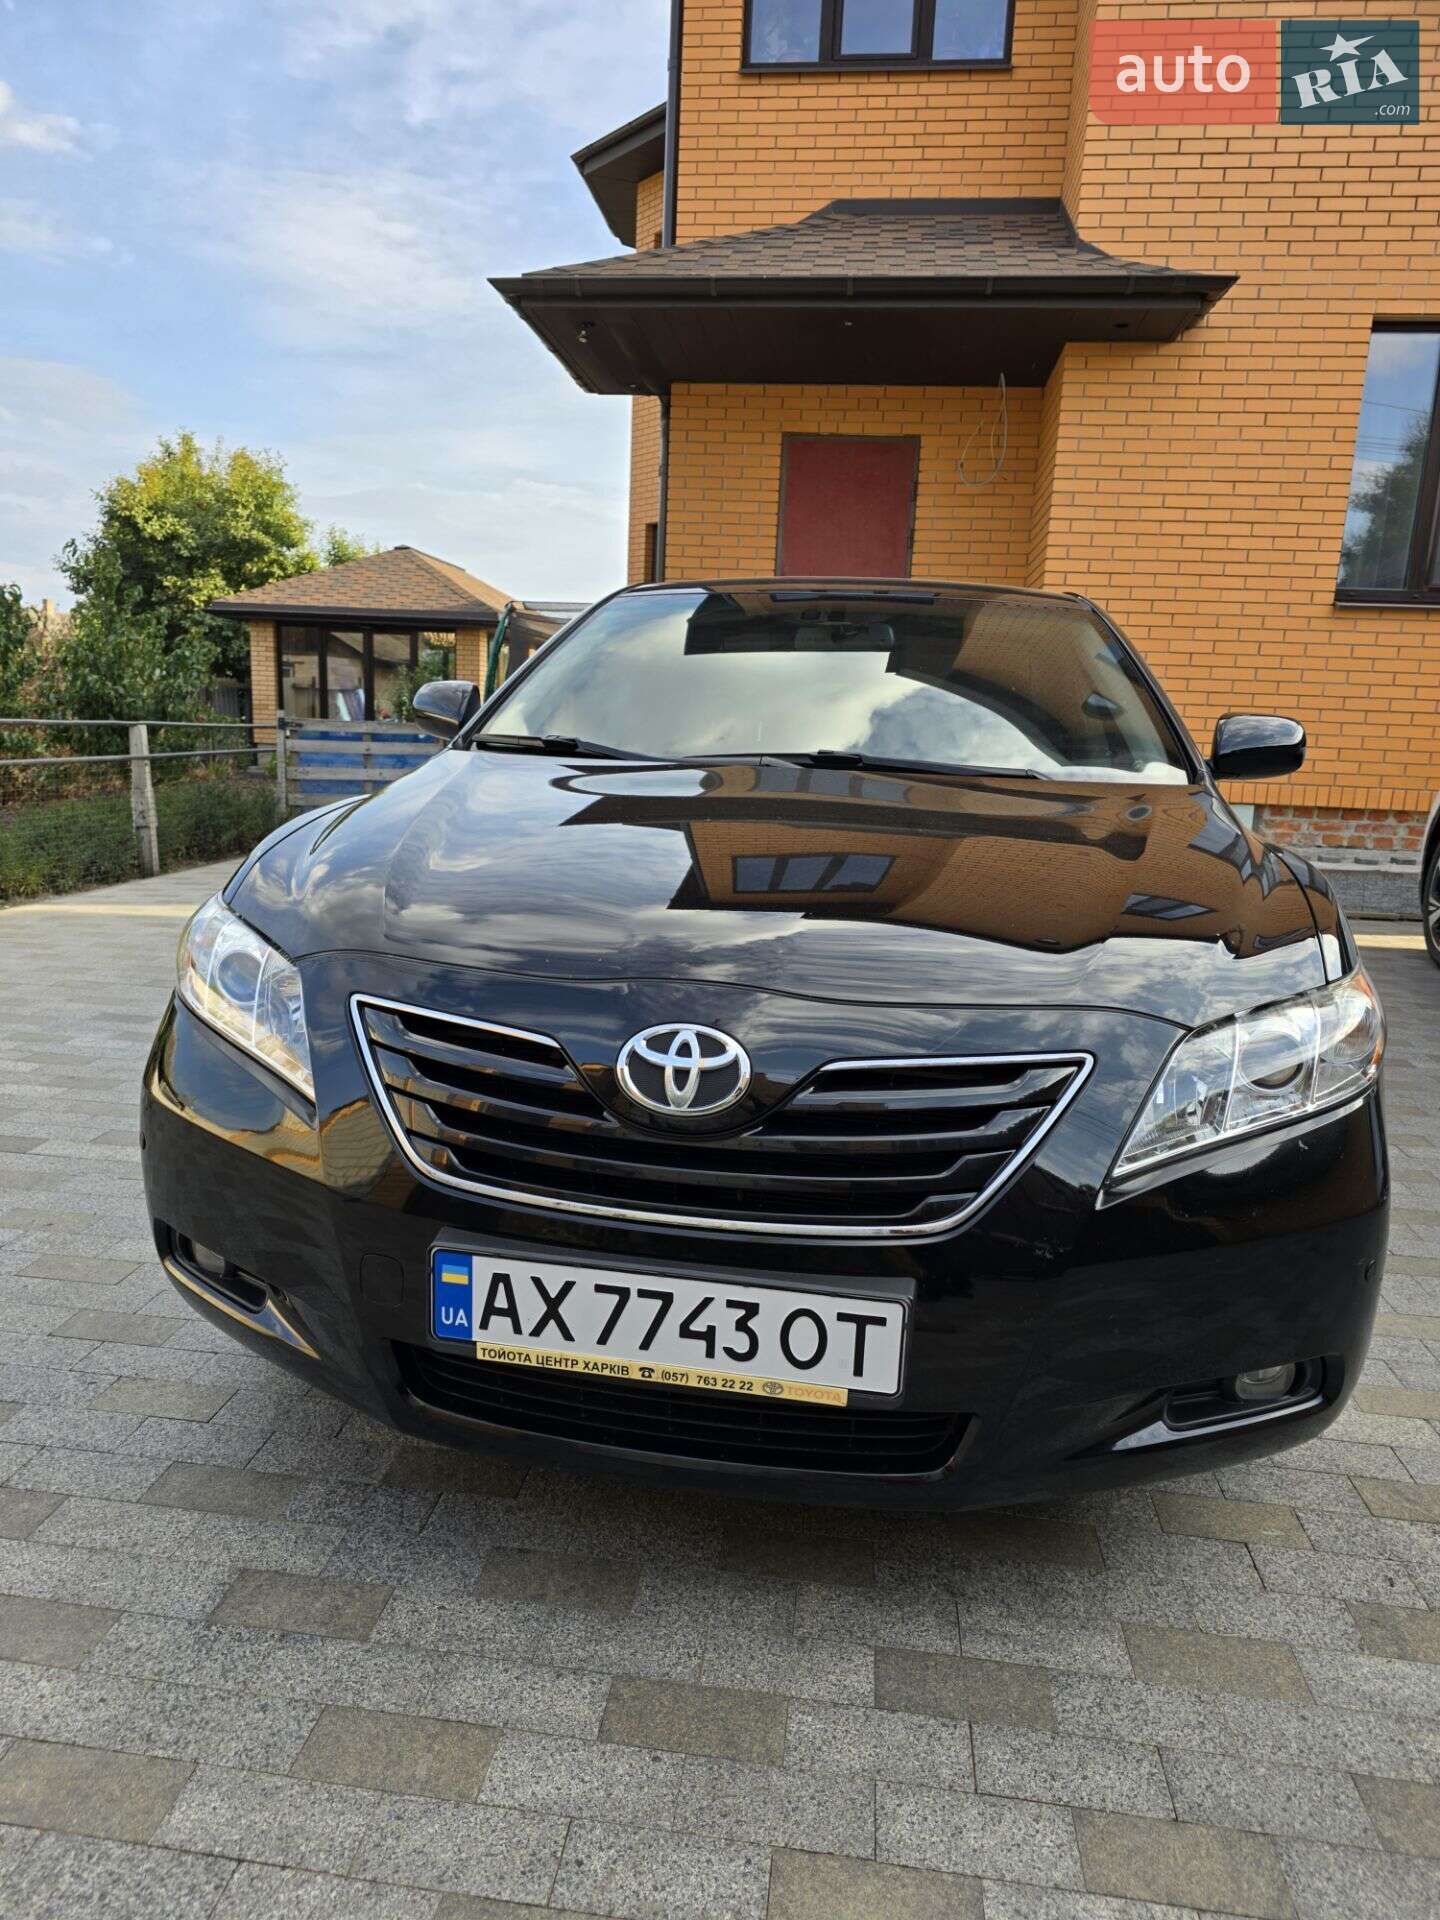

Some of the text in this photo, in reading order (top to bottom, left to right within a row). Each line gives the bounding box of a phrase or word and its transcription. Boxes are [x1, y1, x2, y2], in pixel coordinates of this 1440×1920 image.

[440, 1306, 469, 1328] UA
[478, 1271, 888, 1378] AX 7743 OT
[480, 1347, 754, 1391] ТОЙОТА ЦЕНТР ХАРКІВ (057) 763 22 22
[786, 1386, 843, 1404] TOYOTA
